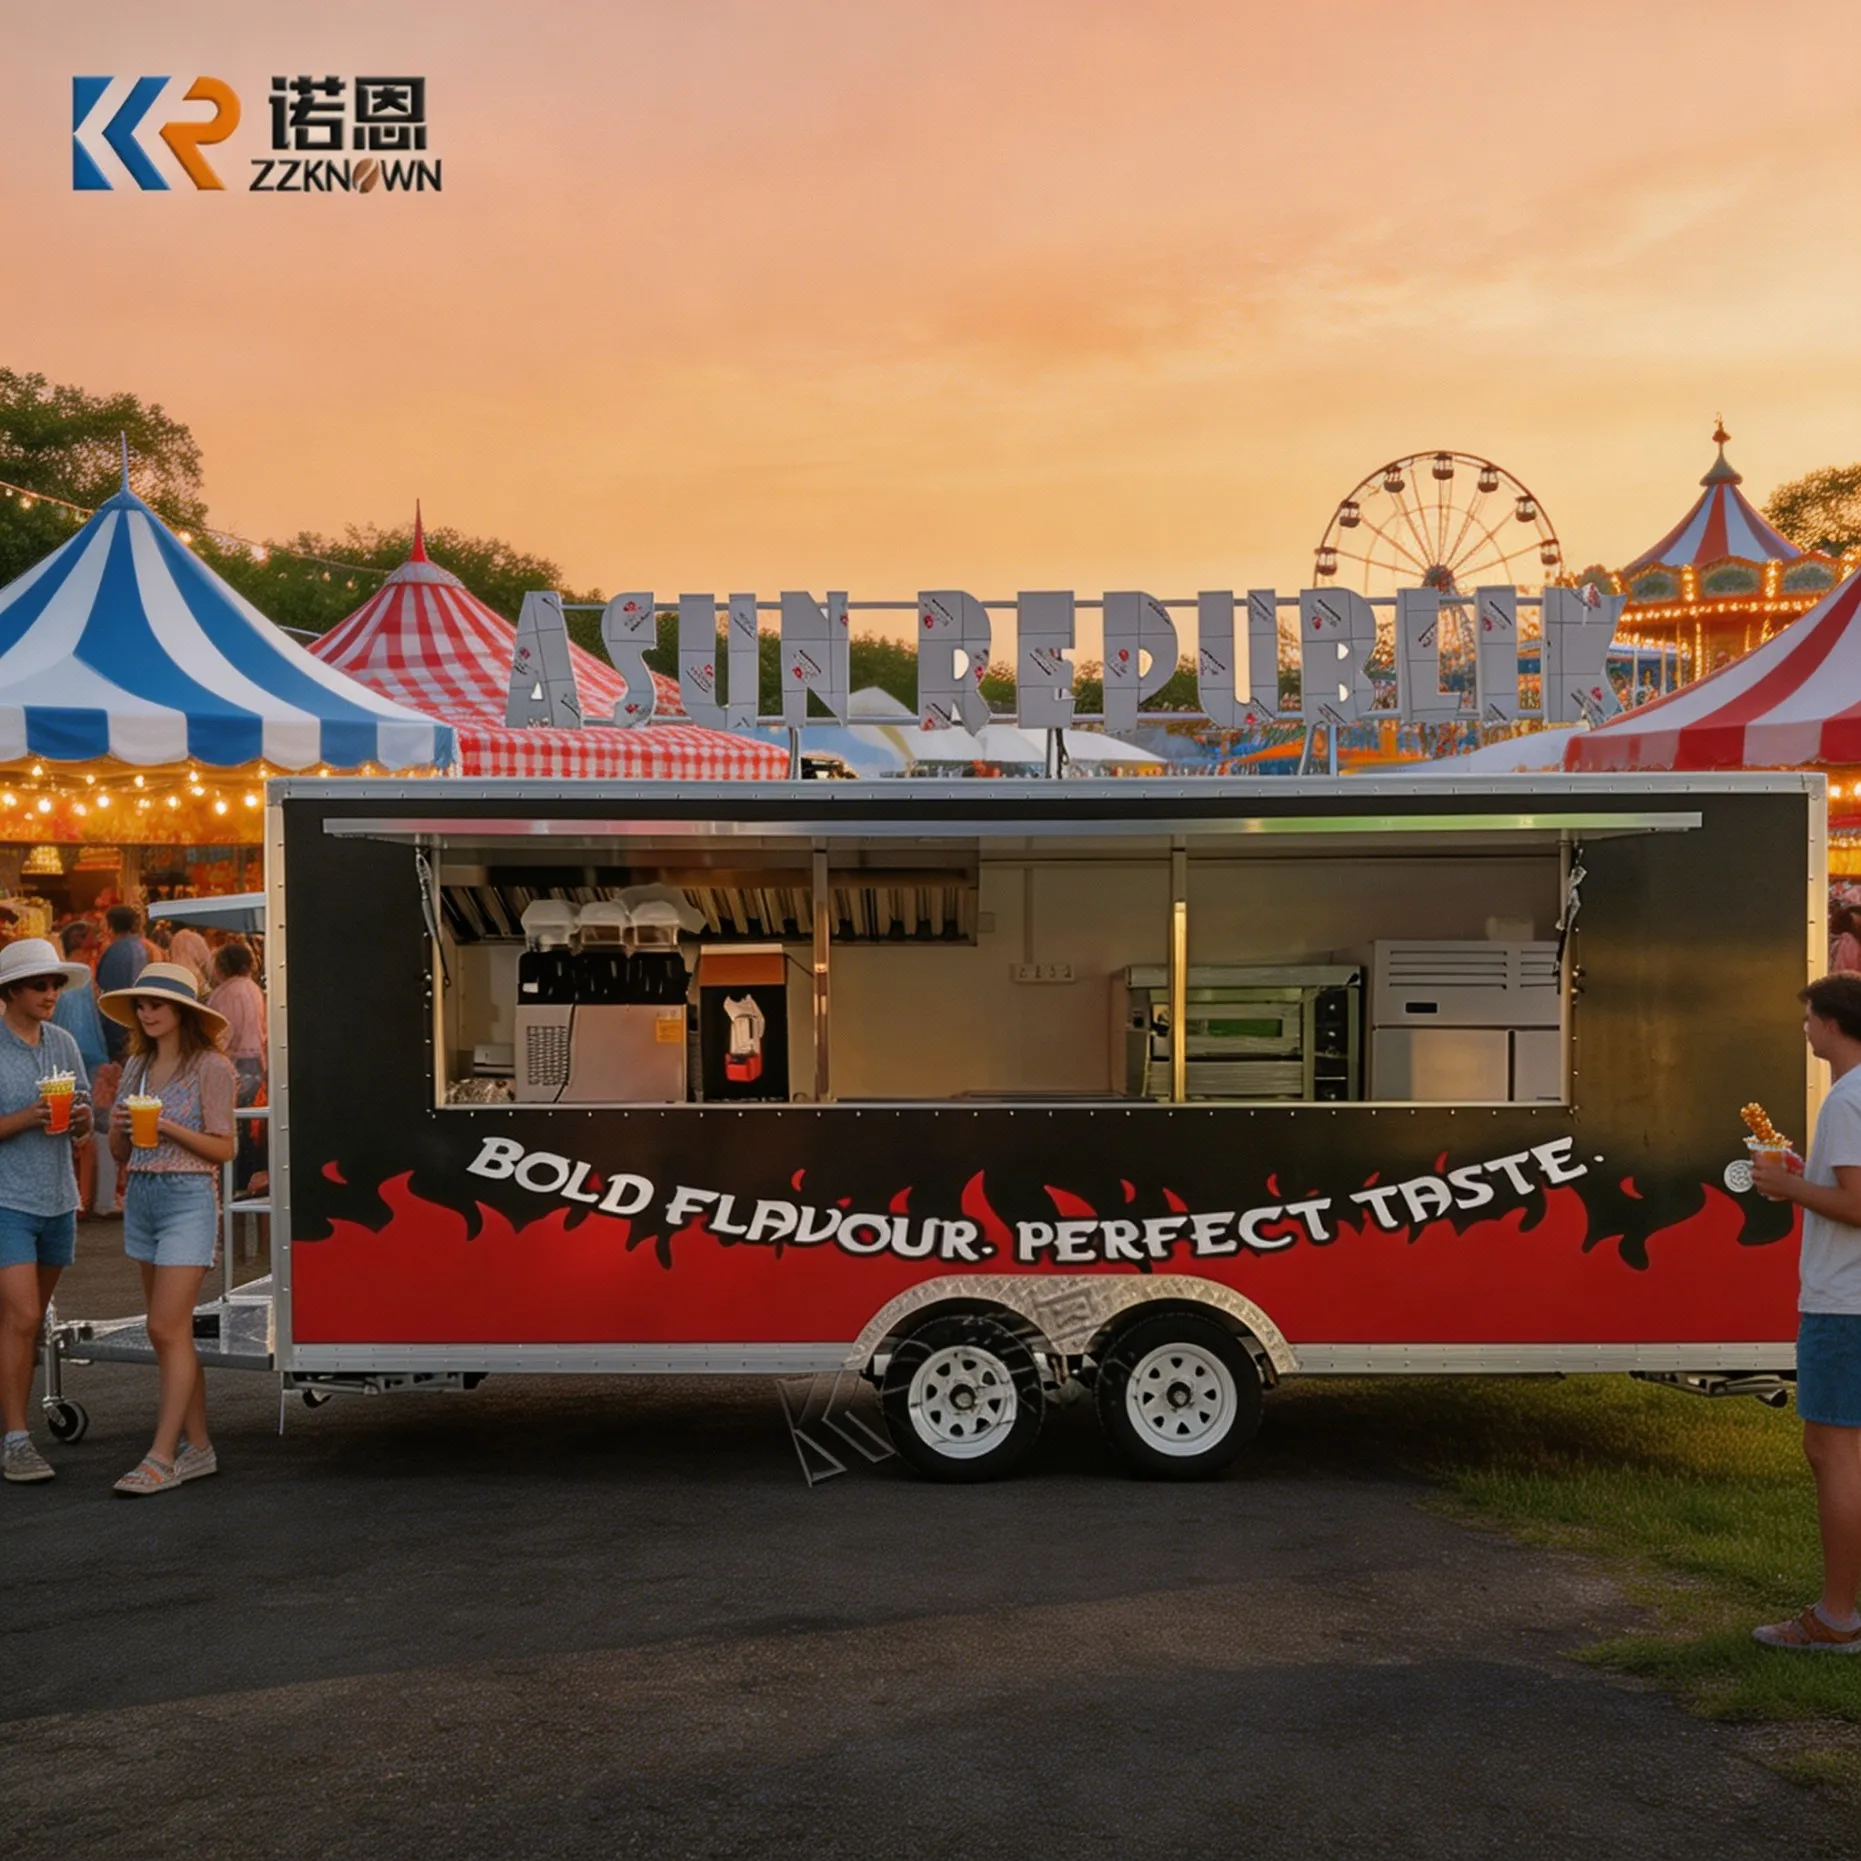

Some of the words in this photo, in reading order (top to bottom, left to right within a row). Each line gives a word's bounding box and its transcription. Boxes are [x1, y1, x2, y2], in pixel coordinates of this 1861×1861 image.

[504, 591, 849, 730] ASUN
[466, 1136, 655, 1216] BOLD
[665, 1185, 995, 1261] FLAVOUR.
[1015, 1197, 1333, 1262] PERFECT
[1349, 1135, 1606, 1230] TASTE.
